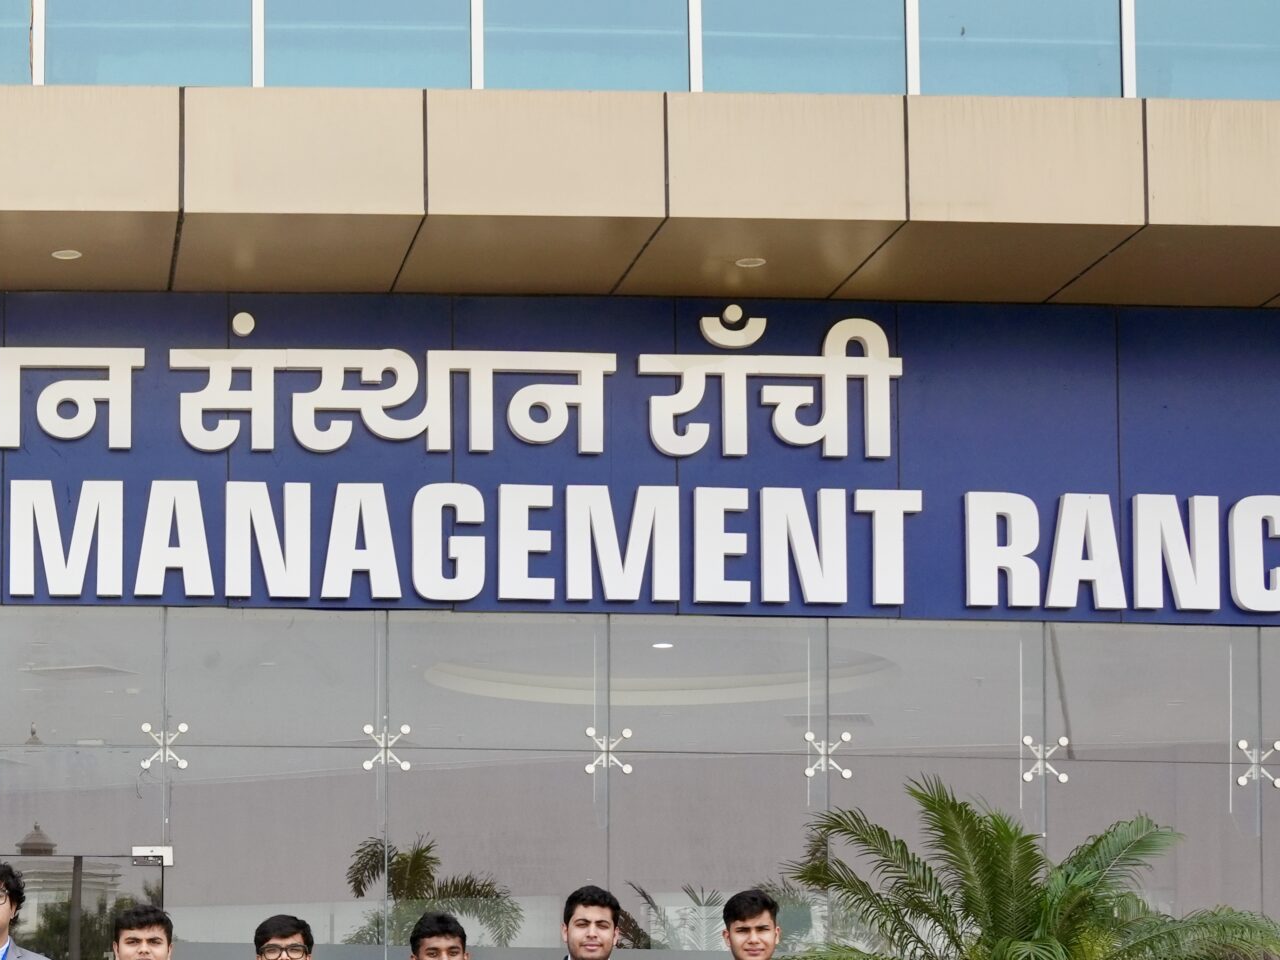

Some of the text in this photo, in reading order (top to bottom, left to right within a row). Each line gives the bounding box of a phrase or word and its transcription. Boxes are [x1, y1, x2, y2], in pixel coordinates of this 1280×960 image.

[169, 311, 618, 453] संस्थान
[637, 304, 903, 458] राँची
[9, 479, 923, 606] MANAGEMENT
[964, 490, 1280, 612] RANC
